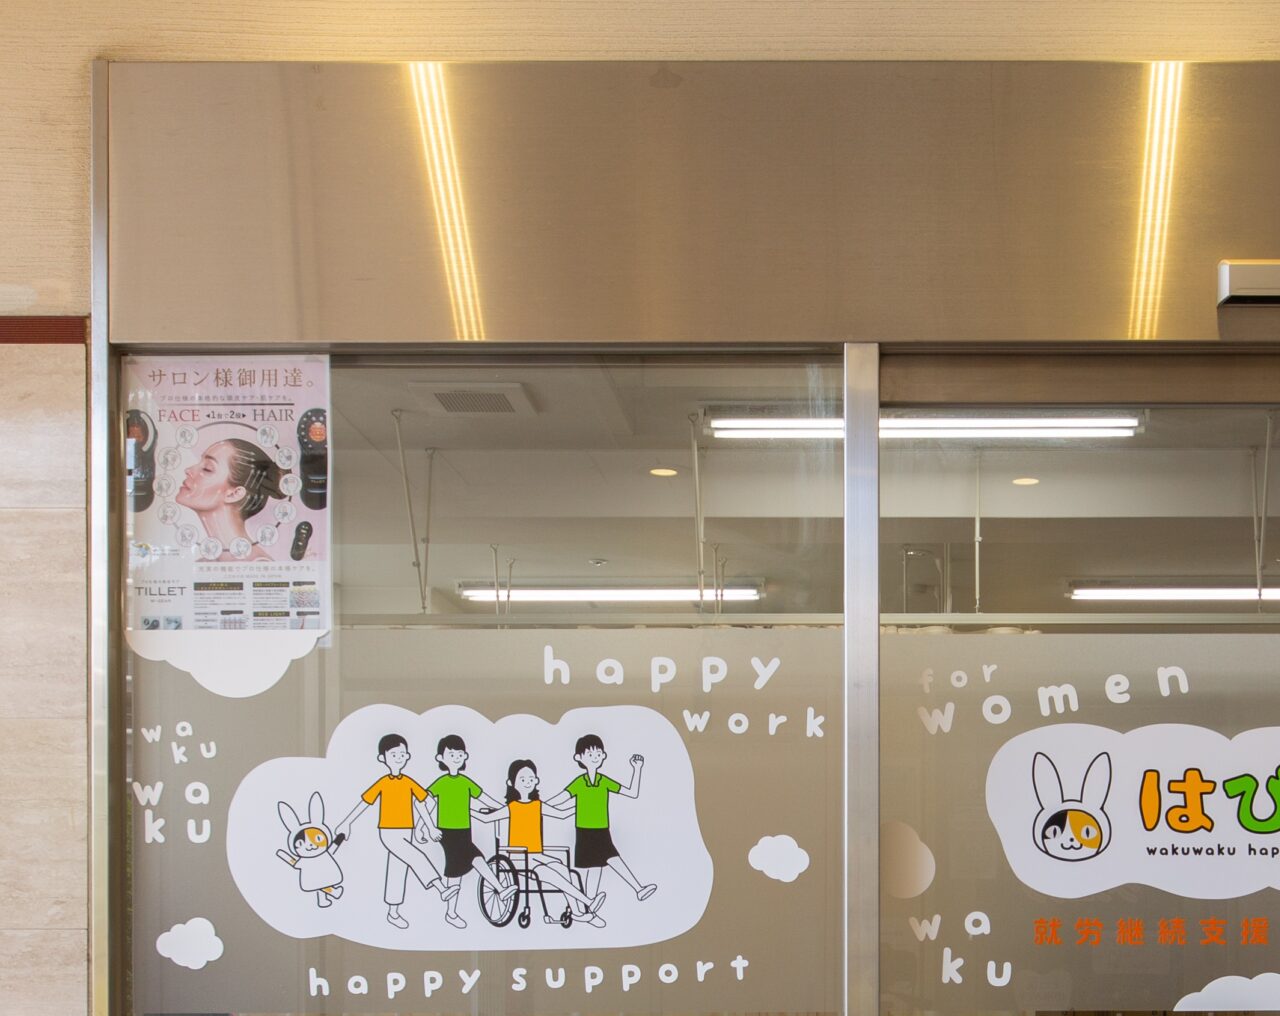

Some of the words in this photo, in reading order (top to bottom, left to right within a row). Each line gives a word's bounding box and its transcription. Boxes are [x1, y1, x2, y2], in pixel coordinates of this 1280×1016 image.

[148, 368, 315, 388] サロン様御用達。
[158, 409, 200, 422] FACE
[253, 408, 295, 422] HAIR
[135, 587, 187, 596] TILLET
[544, 645, 781, 693] happy
[920, 664, 997, 693] for
[918, 666, 1189, 735] women
[683, 707, 825, 737] work
[1146, 844, 1236, 857] wakuwaku
[308, 967, 481, 999] happy
[511, 955, 749, 993] support
